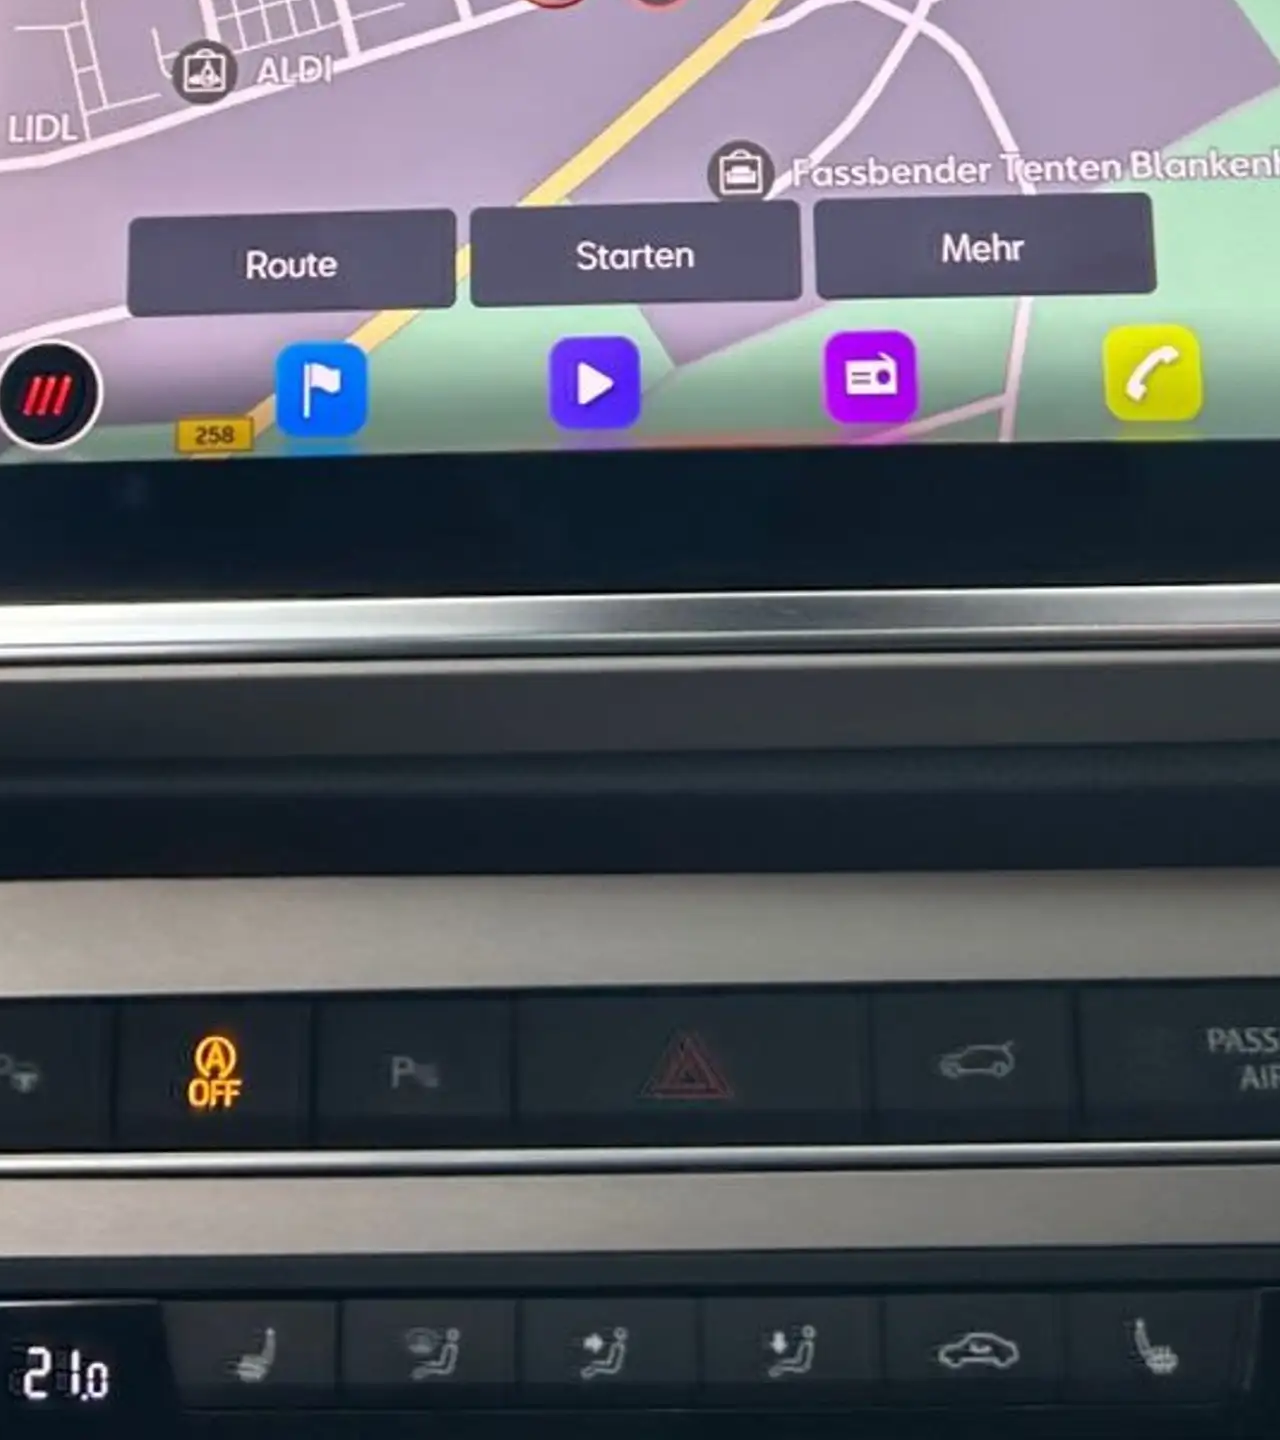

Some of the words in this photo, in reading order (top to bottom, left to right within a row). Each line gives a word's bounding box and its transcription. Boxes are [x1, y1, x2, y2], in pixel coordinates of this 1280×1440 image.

[256, 55, 334, 85] ALDI
[7, 113, 78, 144] LIDL
[791, 156, 991, 189] Fassbender
[1002, 153, 1123, 184] Tenten
[575, 240, 695, 272] Starten
[941, 234, 1025, 264] Mehr
[245, 249, 338, 281] Route
[195, 424, 235, 446] 258
[187, 1079, 242, 1107] OFF
[23, 1345, 109, 1401] 21.0
